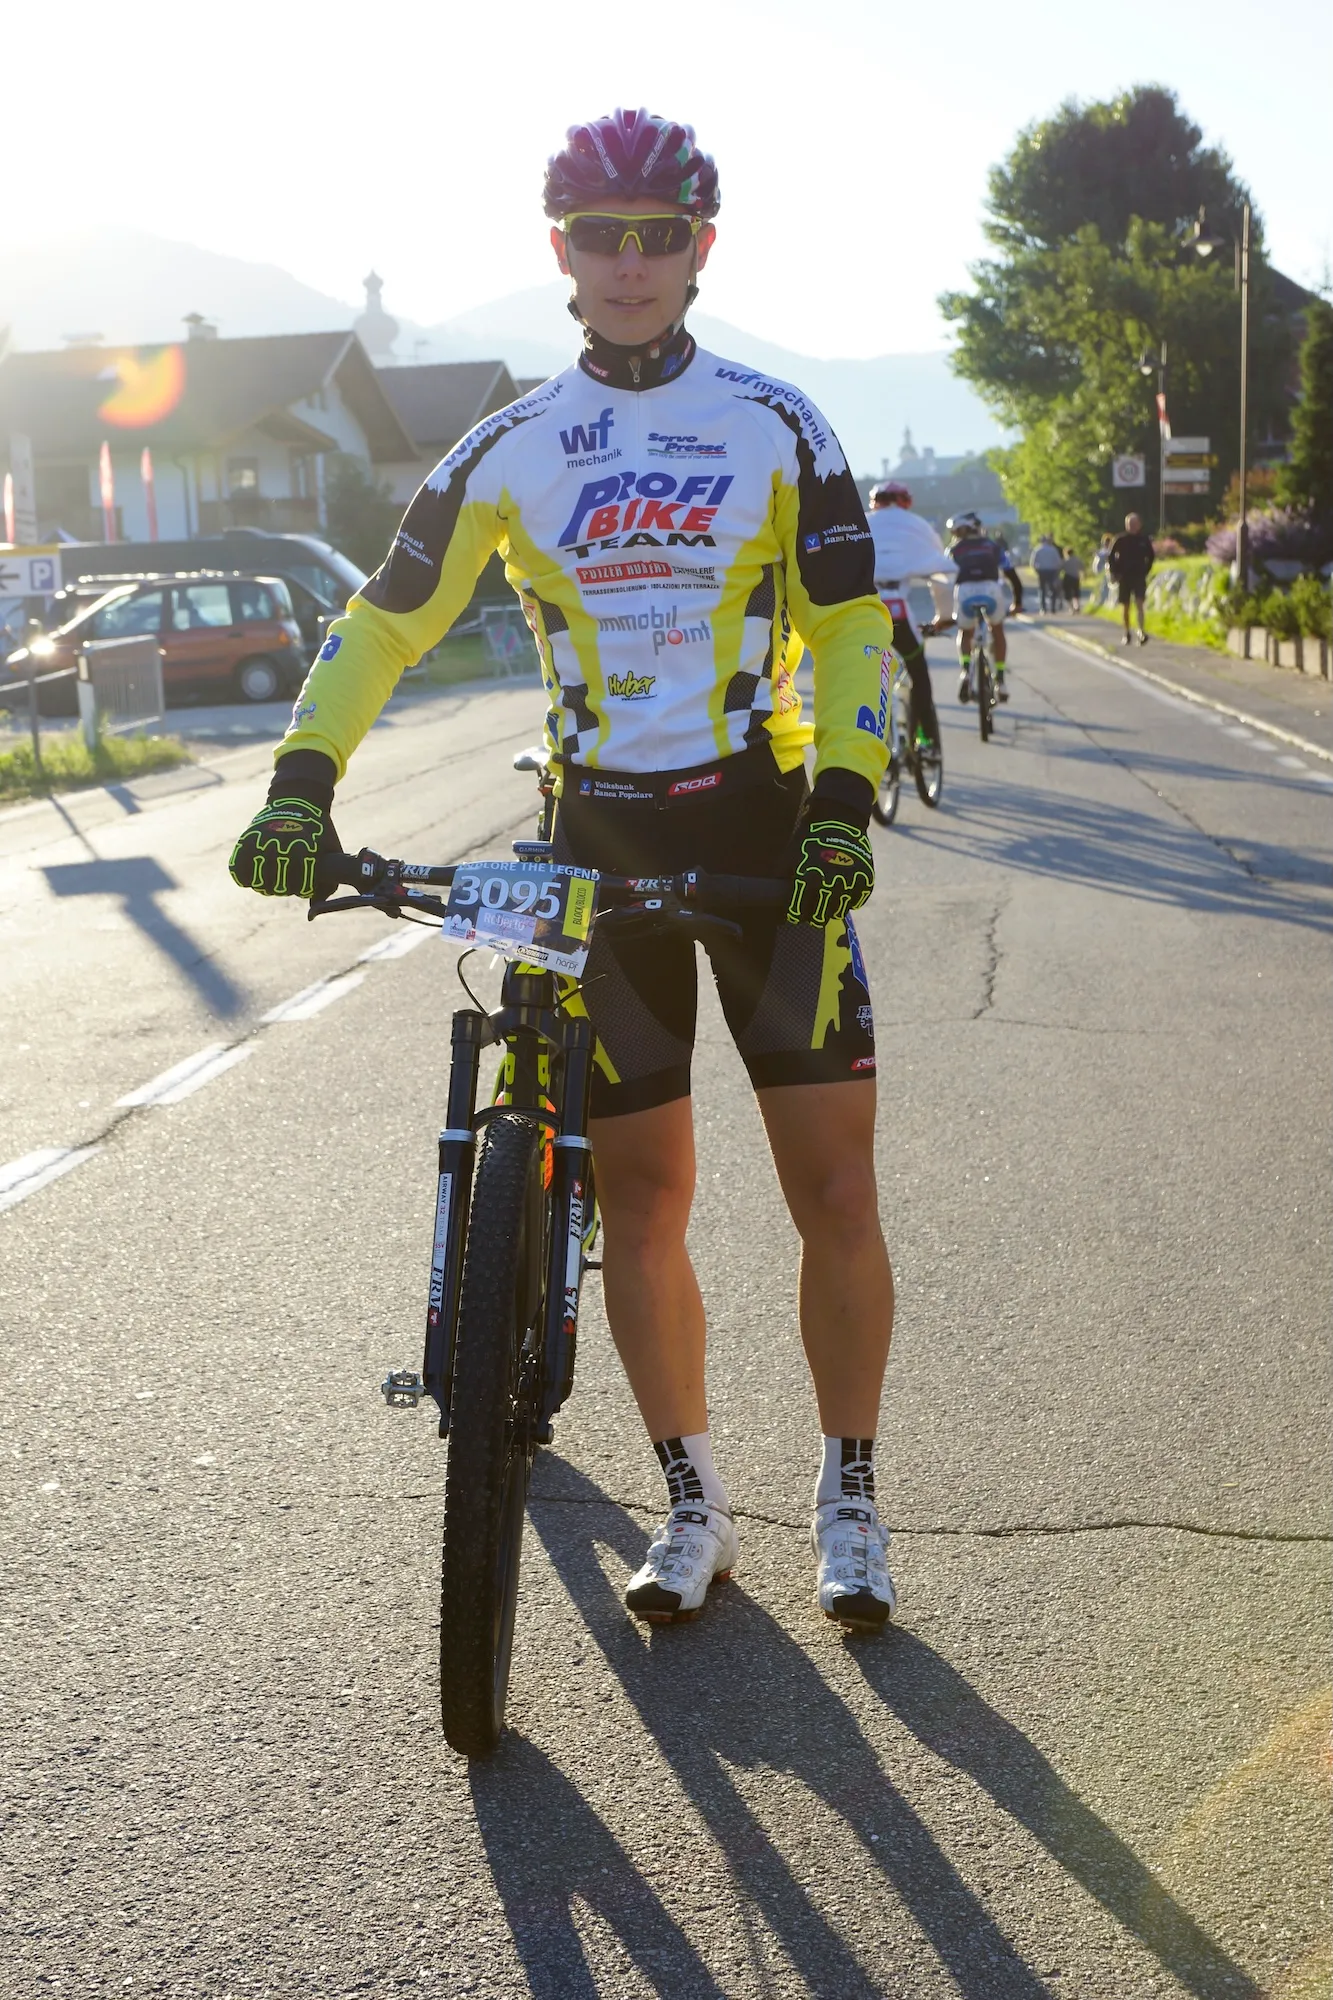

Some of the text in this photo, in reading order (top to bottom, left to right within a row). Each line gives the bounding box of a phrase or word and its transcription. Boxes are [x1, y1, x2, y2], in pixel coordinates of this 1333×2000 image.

[474, 381, 563, 437] mechanik
[752, 380, 827, 452] mechanik
[566, 447, 623, 469] mechanik
[557, 471, 735, 548] PROFI
[587, 498, 719, 541] BIKE
[565, 532, 717, 559] TEAM
[607, 670, 656, 698] Huber
[593, 789, 654, 800] Banca Popolare
[594, 781, 635, 791] Volksbank
[518, 846, 546, 854] GARMIN
[519, 862, 547, 872] THE
[549, 863, 601, 881] LEGEND
[454, 875, 563, 920] 3095
[555, 956, 579, 972] harpf
[441, 1175, 449, 1204] AIRWAY
[569, 1194, 583, 1240] FRM
